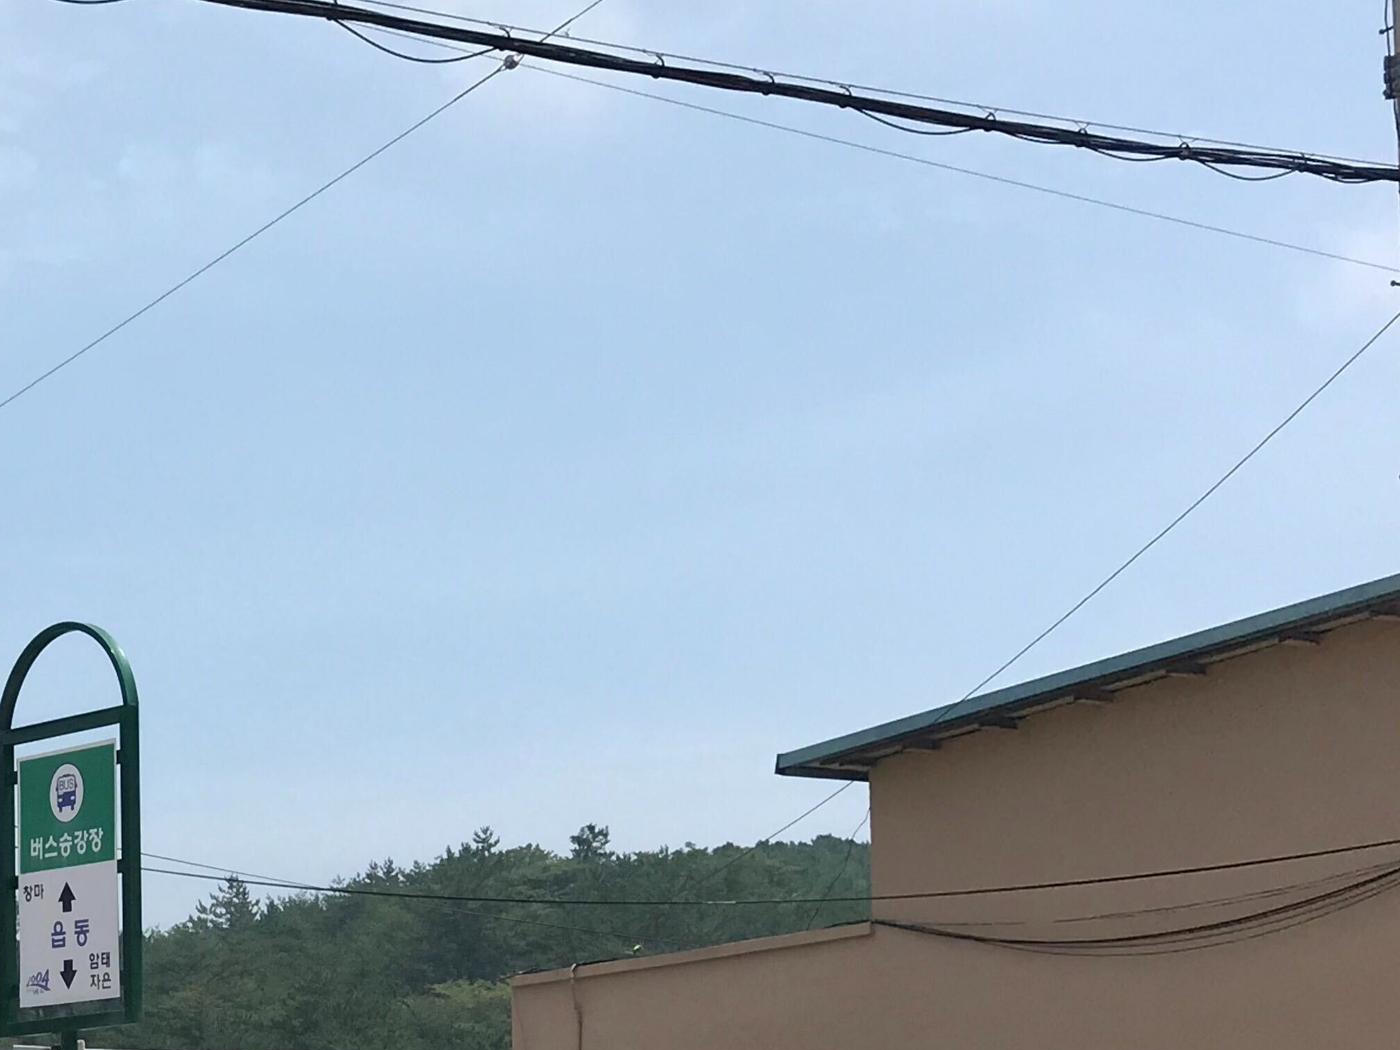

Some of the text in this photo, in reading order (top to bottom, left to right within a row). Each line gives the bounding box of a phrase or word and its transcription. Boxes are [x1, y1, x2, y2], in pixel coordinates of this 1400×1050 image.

[59, 778, 75, 791] BUS
[30, 827, 103, 859] 버스승강장
[23, 884, 44, 902] 창마
[89, 952, 111, 970] 암태
[90, 972, 111, 990] 자은
